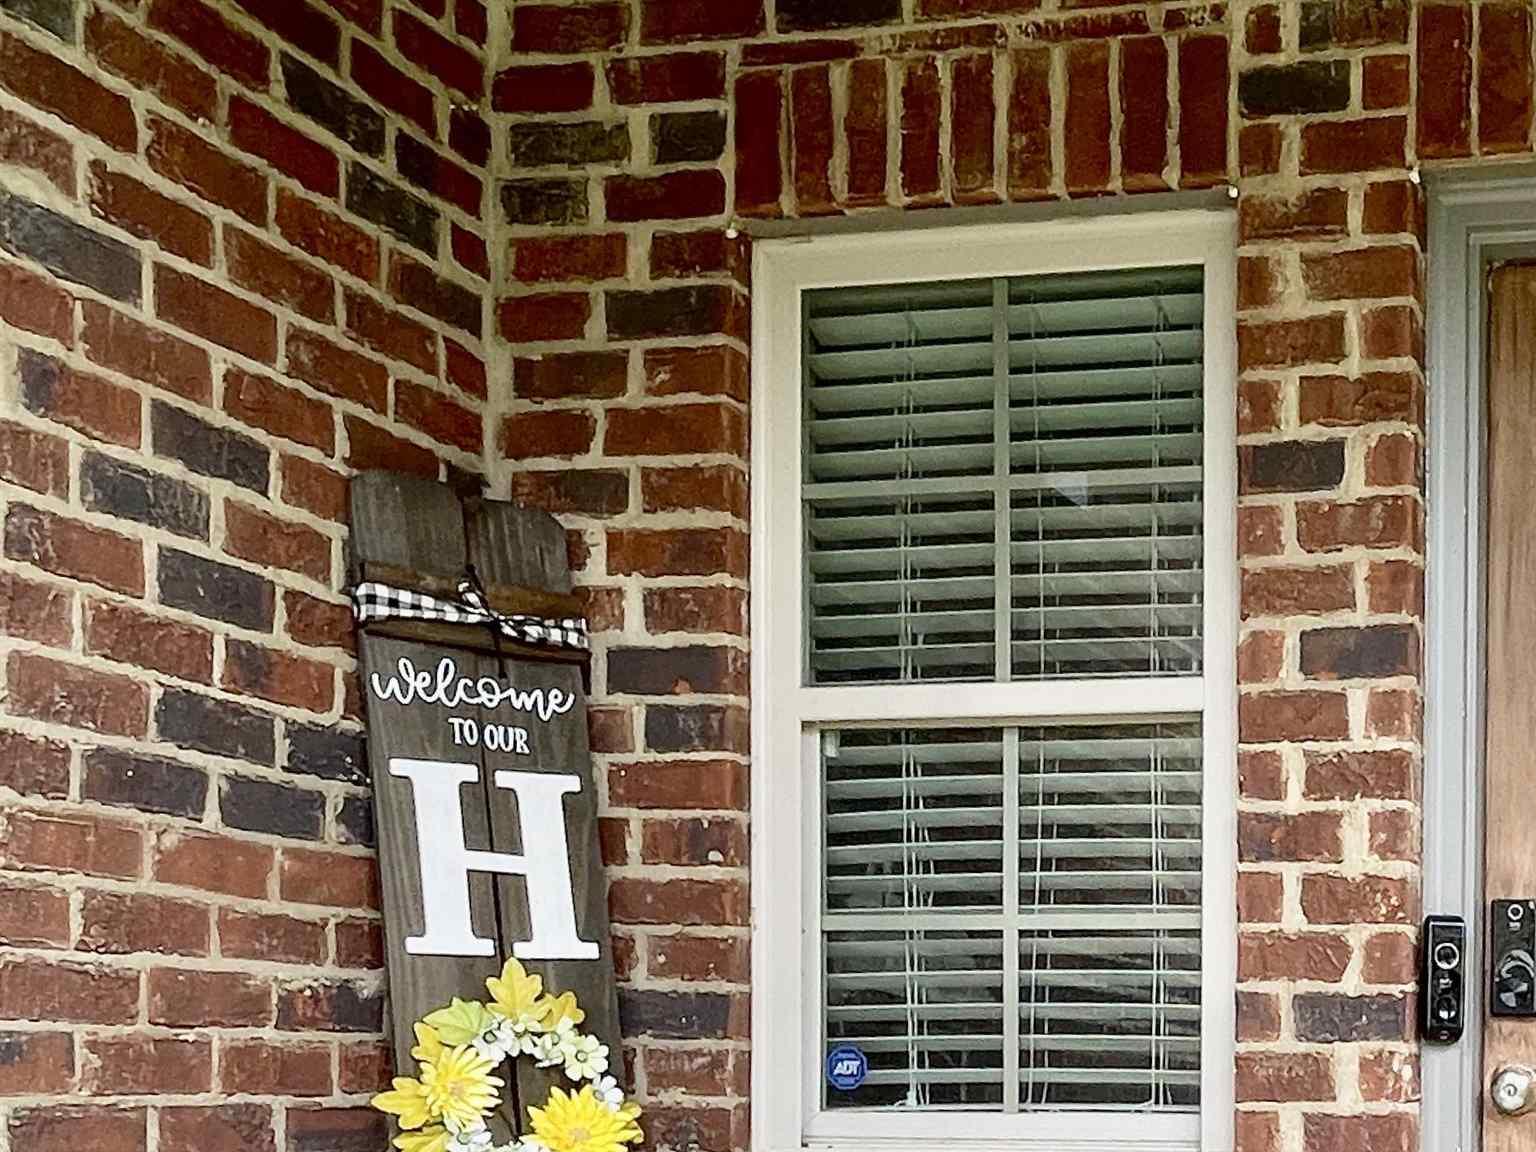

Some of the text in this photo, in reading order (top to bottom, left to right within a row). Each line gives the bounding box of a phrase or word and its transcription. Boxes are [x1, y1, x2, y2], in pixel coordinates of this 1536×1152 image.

[370, 657, 576, 722] welcome
[448, 717, 530, 754] TO OUR
[833, 1060, 861, 1075] ADT
